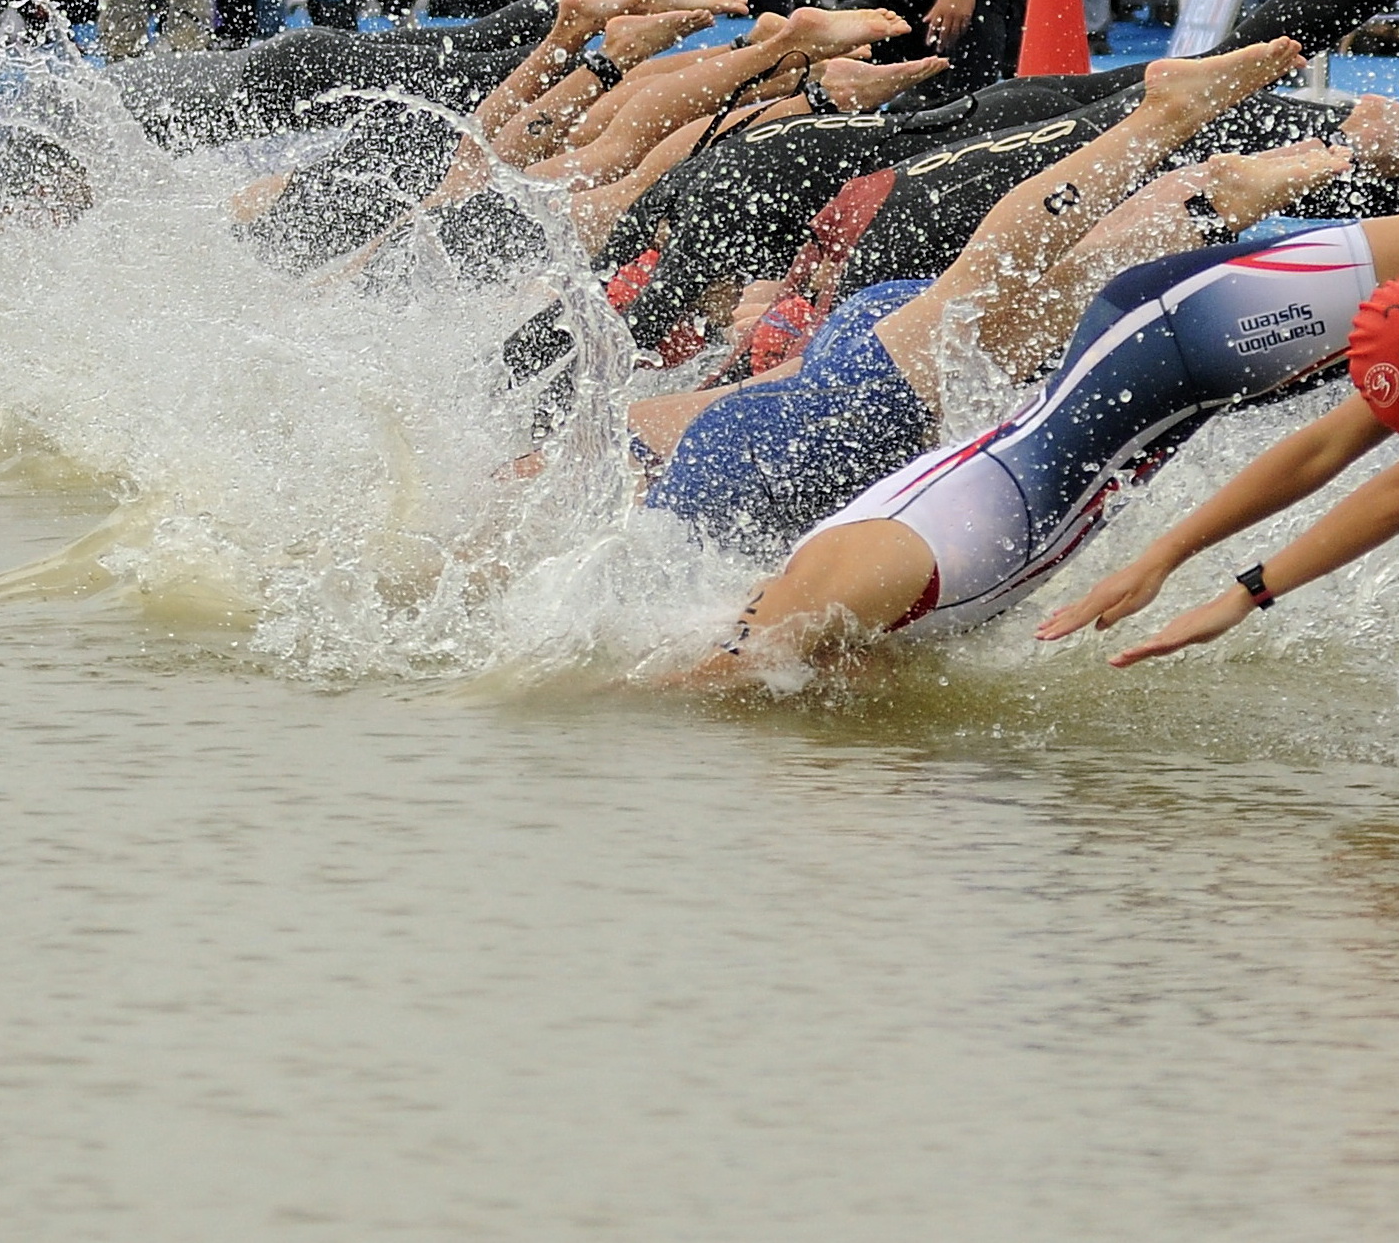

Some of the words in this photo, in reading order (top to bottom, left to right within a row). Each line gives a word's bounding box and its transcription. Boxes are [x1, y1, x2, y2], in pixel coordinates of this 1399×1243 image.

[746, 116, 886, 142] orca
[907, 120, 1077, 176] orca
[1241, 303, 1313, 332] System
[1238, 320, 1326, 354] Champion
